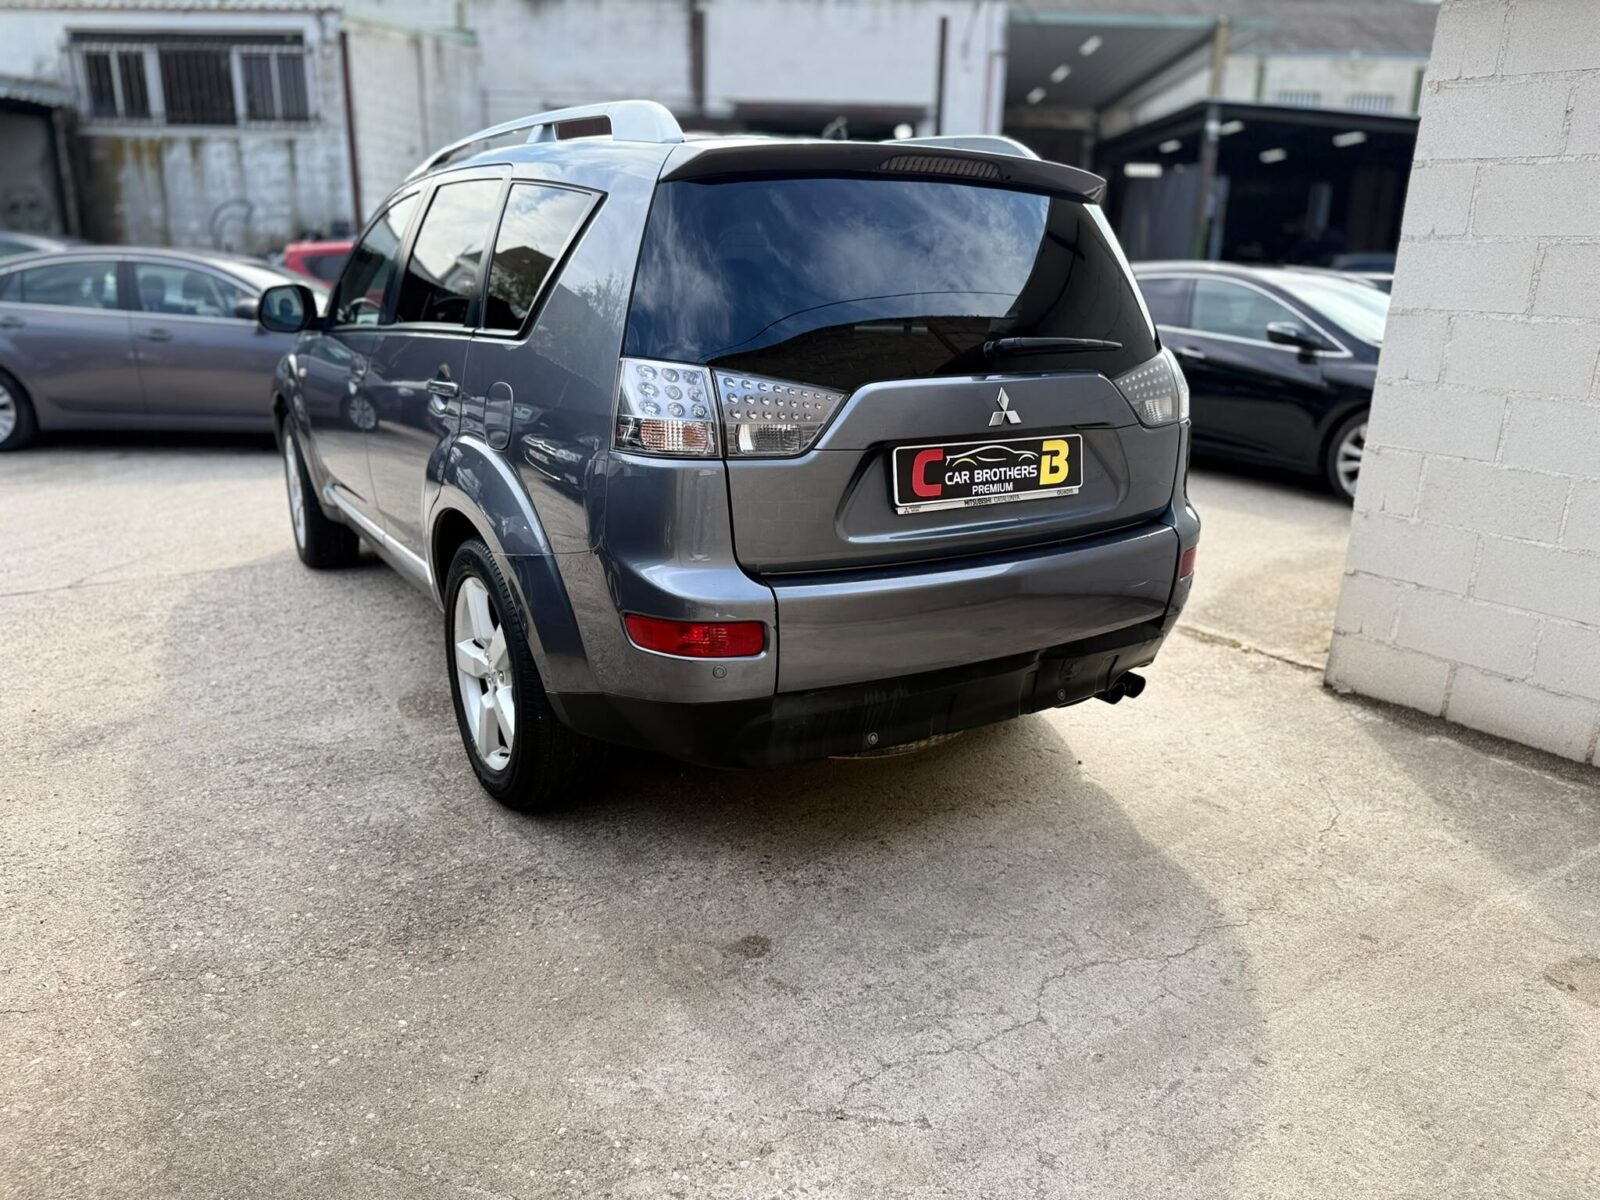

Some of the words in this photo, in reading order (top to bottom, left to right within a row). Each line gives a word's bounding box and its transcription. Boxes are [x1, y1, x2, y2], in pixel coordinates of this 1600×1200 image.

[1039, 439, 1069, 485] B
[912, 448, 944, 497] C
[945, 470, 970, 485] CAR
[974, 465, 1038, 482] BROTHERS
[972, 482, 1014, 495] PREMIUM
[964, 497, 992, 507] MITSUBISHI
